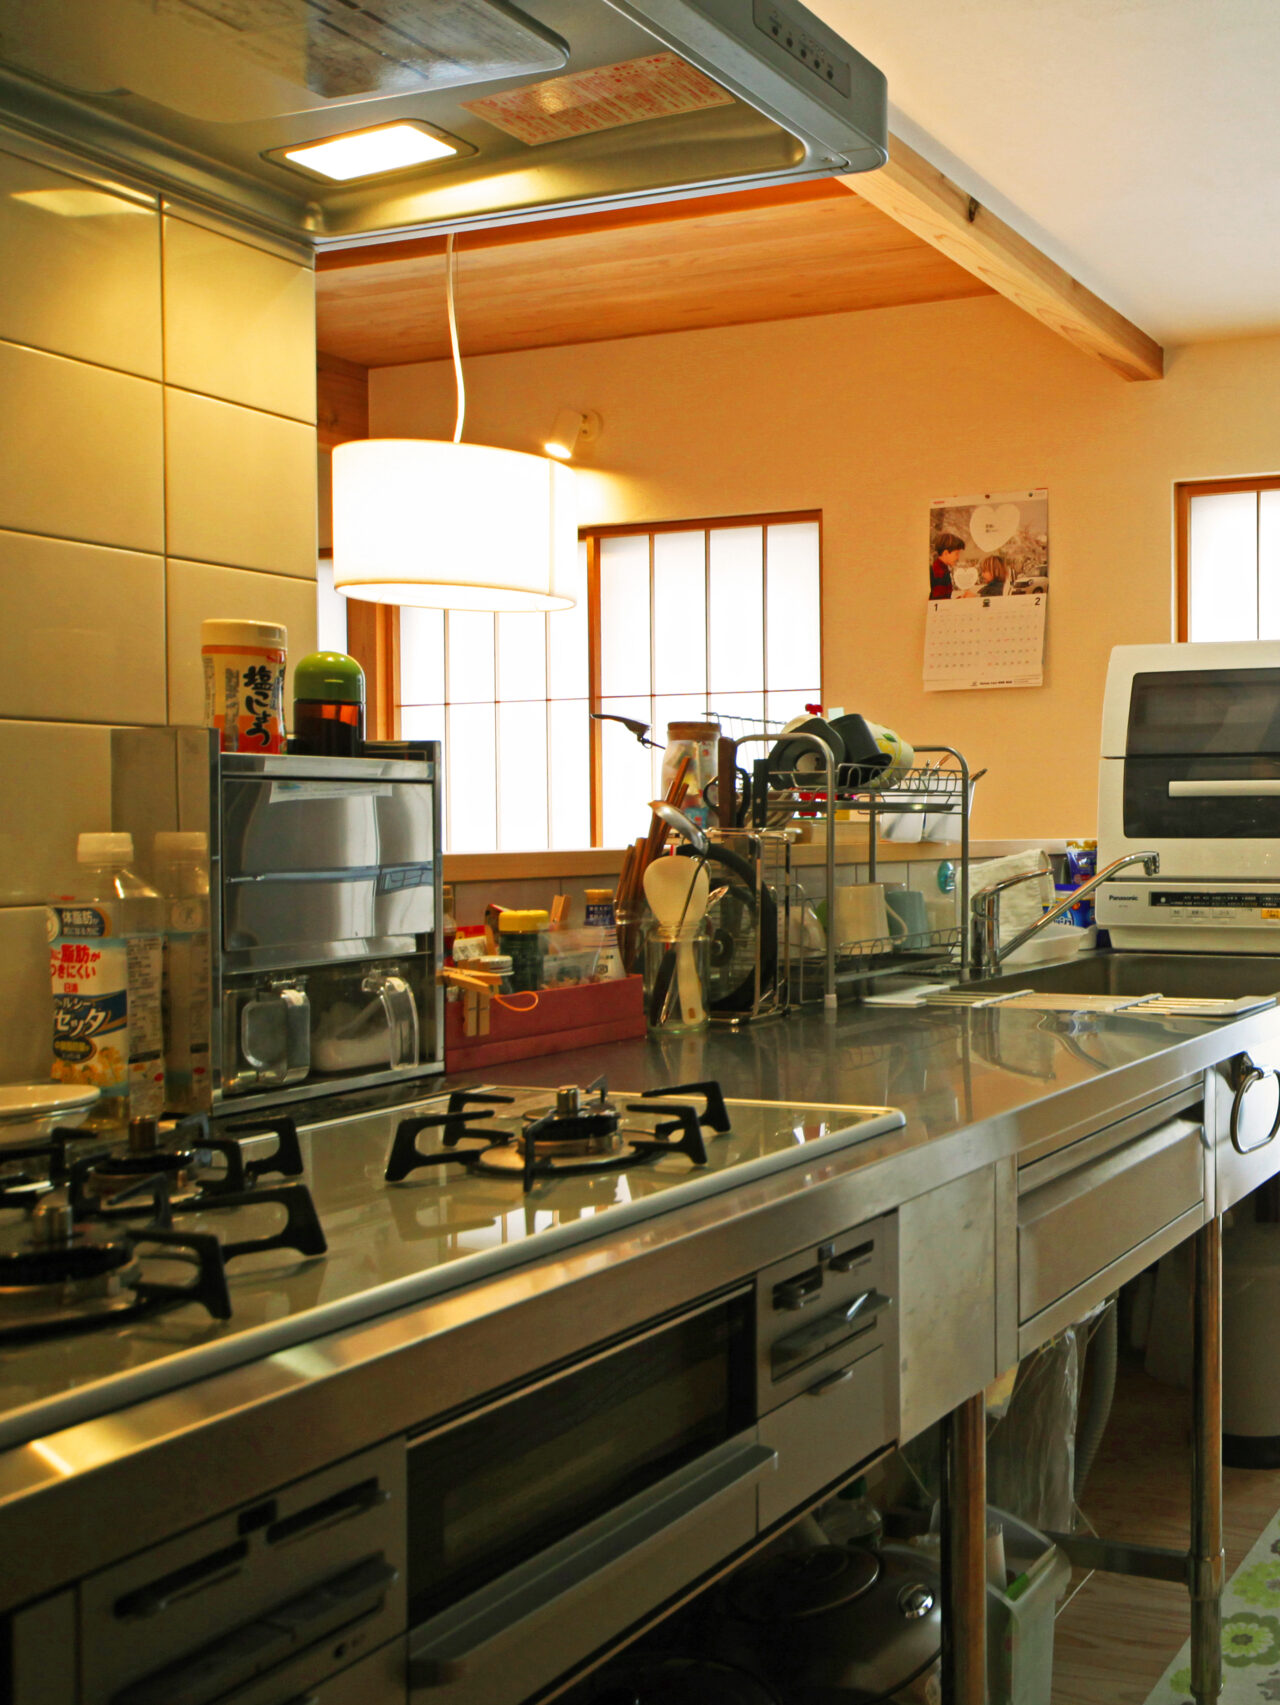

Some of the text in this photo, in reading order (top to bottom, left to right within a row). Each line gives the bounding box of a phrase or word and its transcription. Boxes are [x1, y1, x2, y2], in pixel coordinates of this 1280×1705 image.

[1034, 596, 1041, 606] 2
[933, 603, 938, 612] 1
[243, 664, 273, 746] 塩こしょう
[1108, 894, 1139, 902] Panasonic
